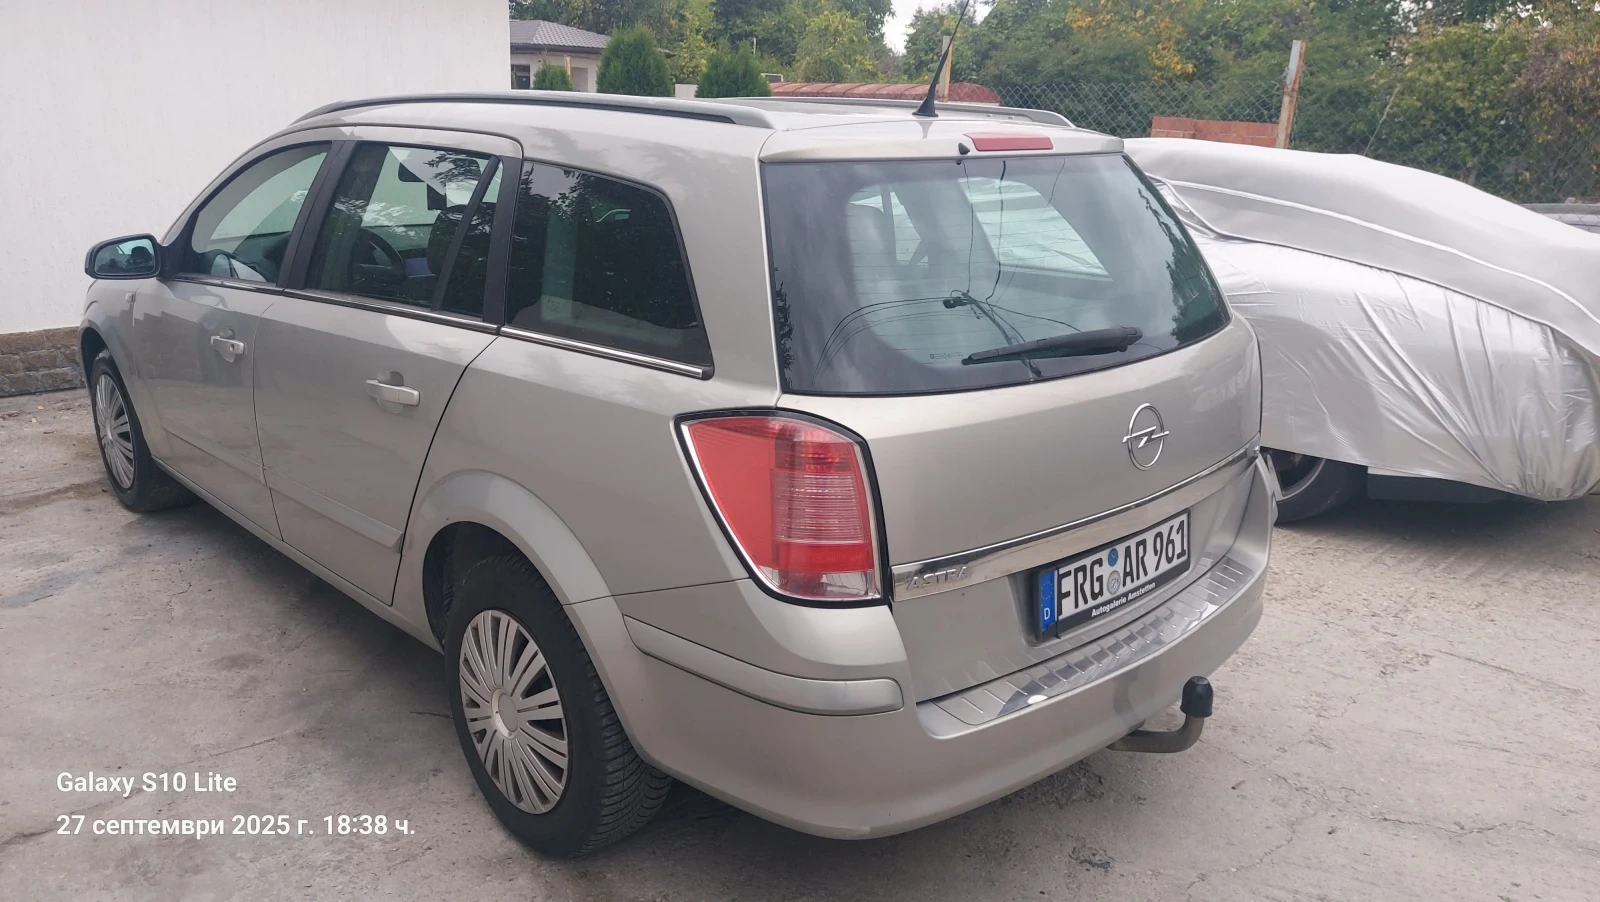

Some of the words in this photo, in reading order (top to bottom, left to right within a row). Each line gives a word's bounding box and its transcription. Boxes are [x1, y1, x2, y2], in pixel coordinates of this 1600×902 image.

[906, 566, 968, 590] ASTRA
[1058, 557, 1104, 617] FRG
[1122, 538, 1149, 588] AR
[1153, 519, 1187, 572] 961
[1043, 607, 1051, 620] D
[1091, 596, 1127, 617] Autogalerie
[1128, 582, 1156, 601] Amstetten
